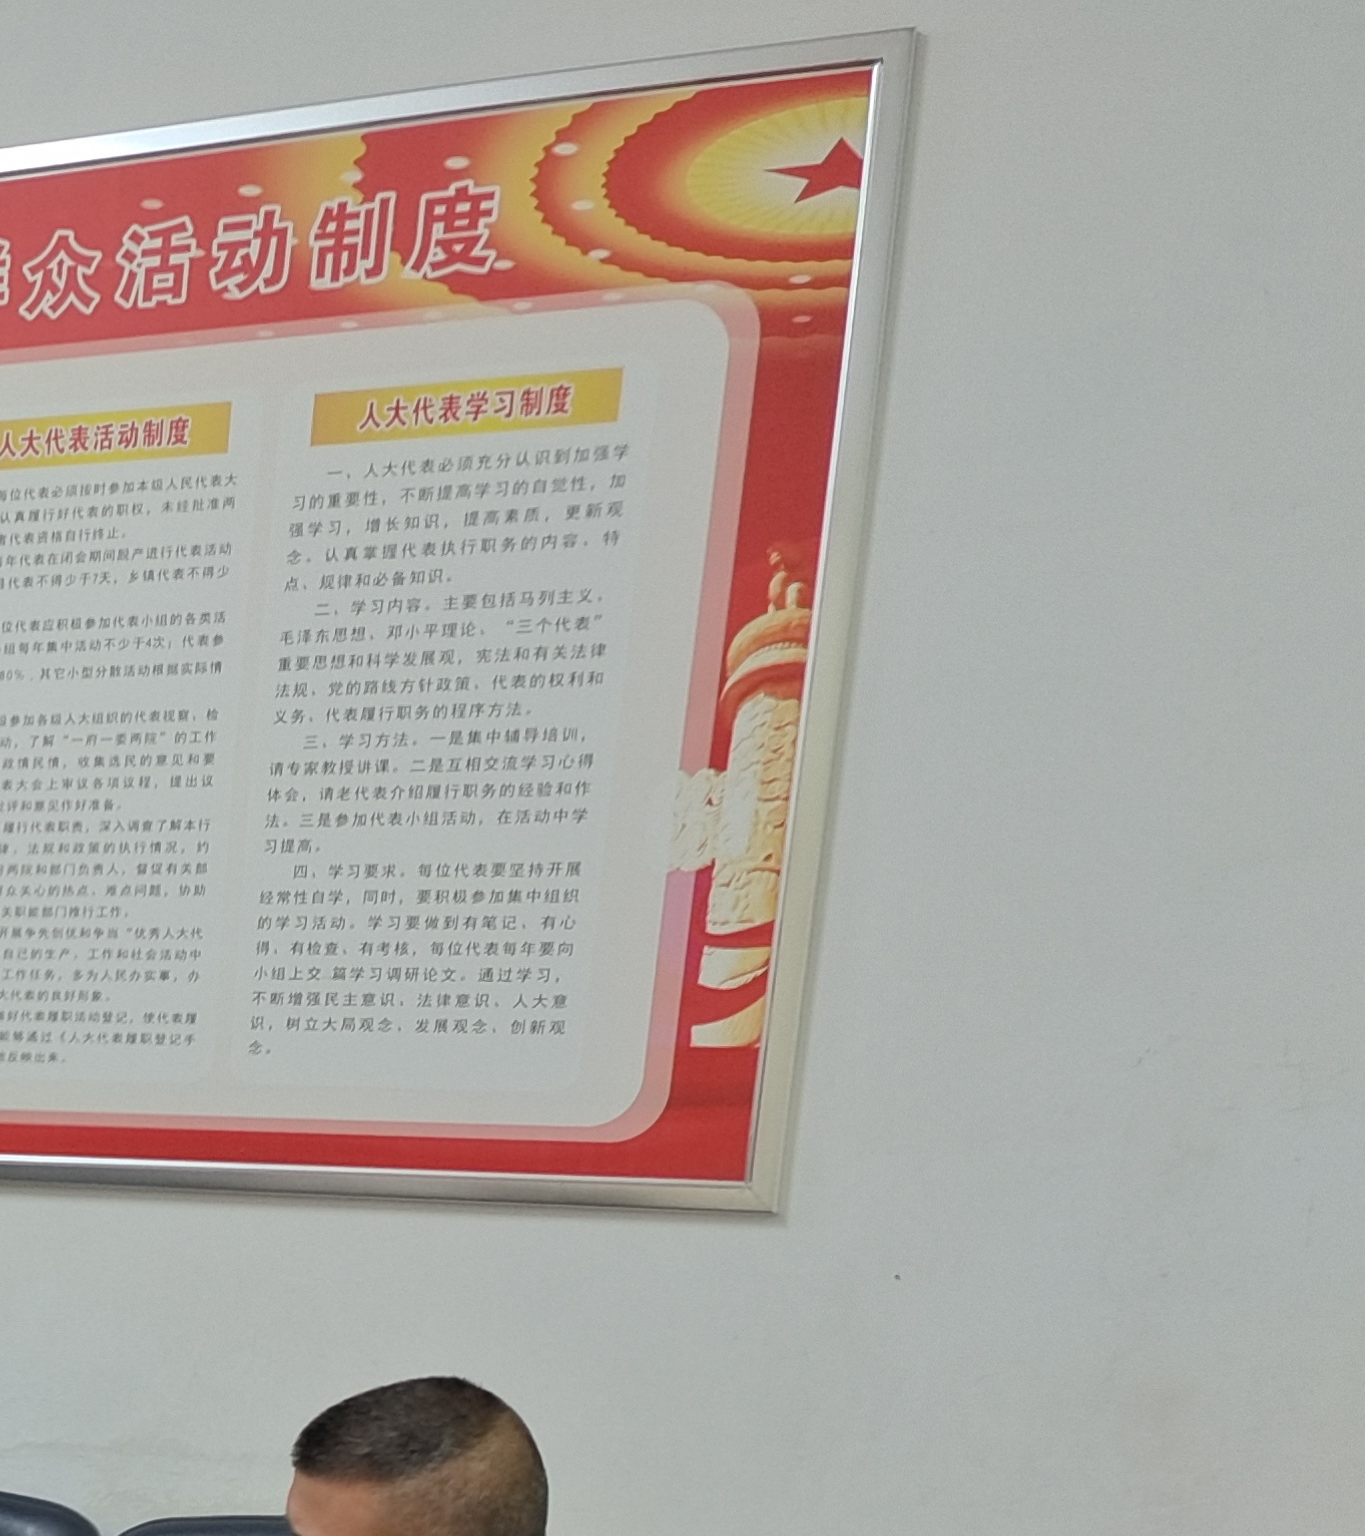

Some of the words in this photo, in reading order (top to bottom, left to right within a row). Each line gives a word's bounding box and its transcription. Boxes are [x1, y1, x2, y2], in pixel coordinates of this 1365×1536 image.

[357, 384, 573, 431] 人大代表学习制度
[283, 567, 451, 592] 点、规律和必备知识。
[264, 838, 320, 854] 习提高。
[248, 1040, 270, 1055] 念。
